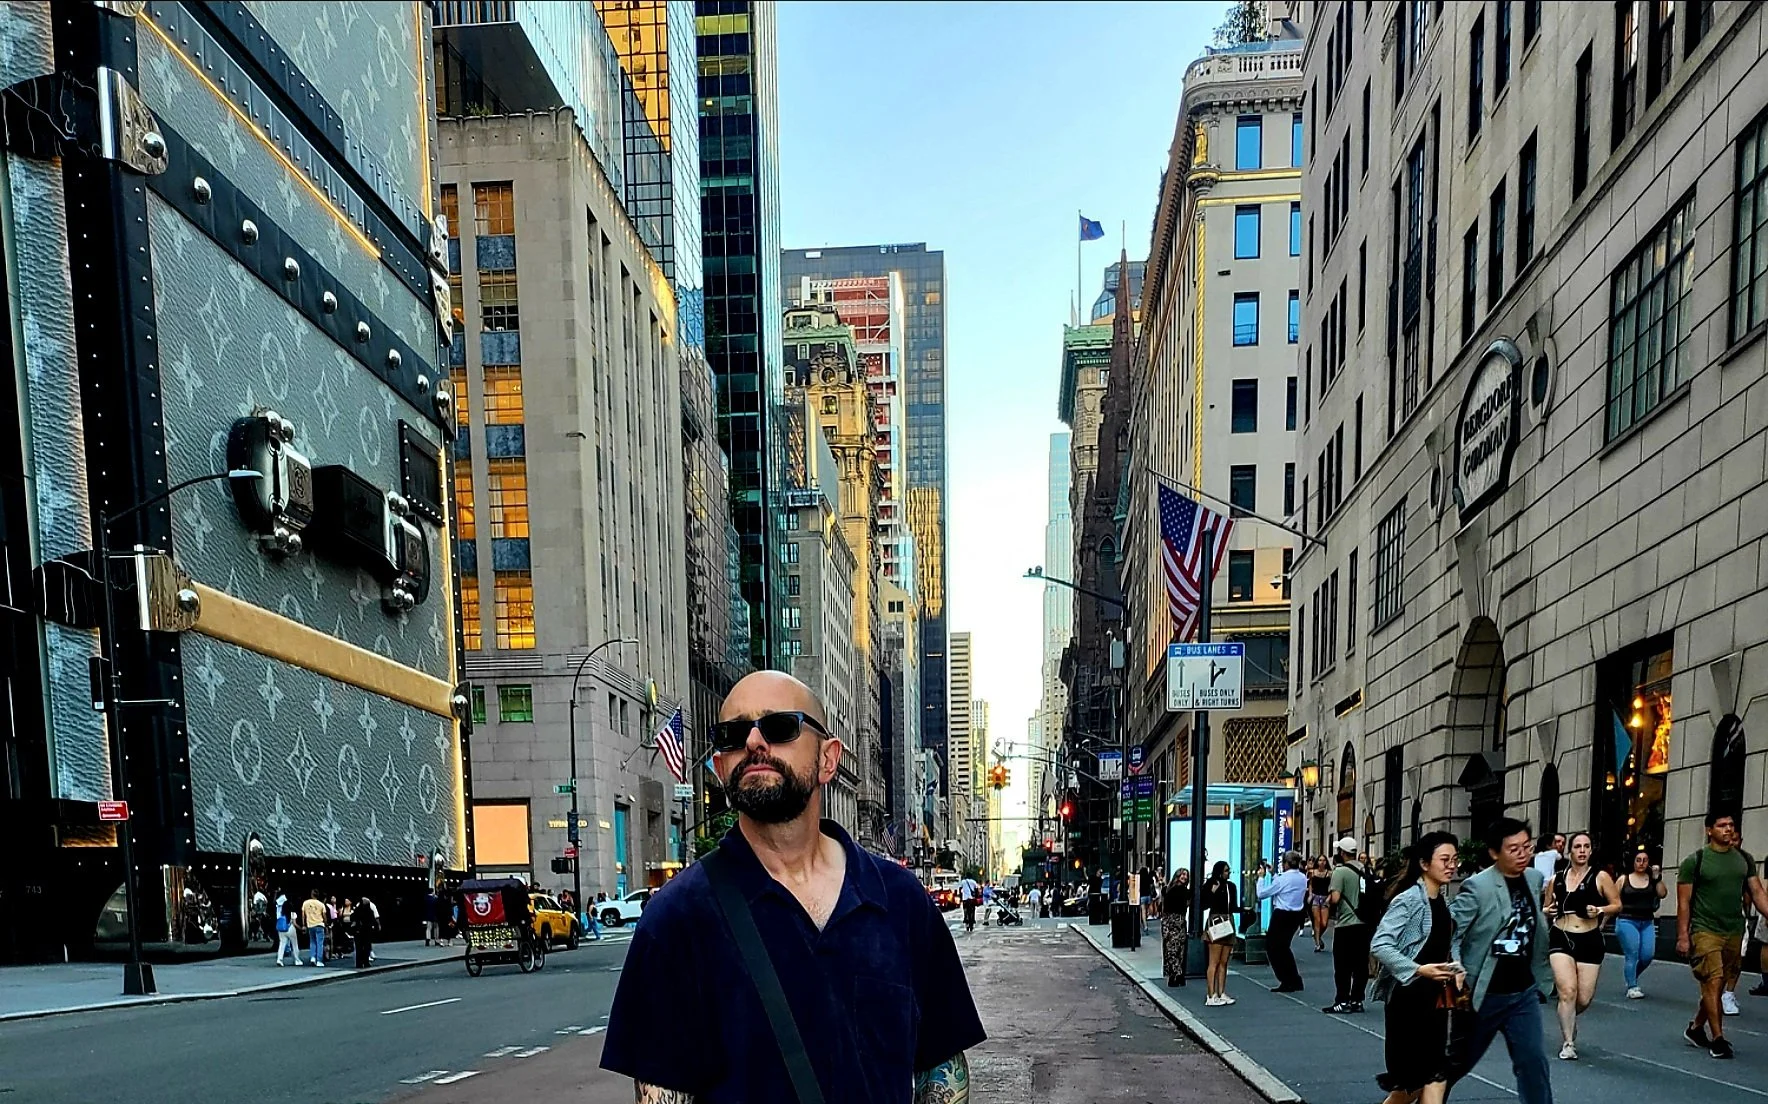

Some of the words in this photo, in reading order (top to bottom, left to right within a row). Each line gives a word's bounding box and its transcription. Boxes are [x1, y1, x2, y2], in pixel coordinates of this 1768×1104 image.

[1186, 646, 1200, 655] BUS
[1202, 645, 1226, 655] LANES
[1199, 688, 1218, 696] BUSES
[1219, 688, 1234, 696] ONLY
[1202, 698, 1219, 706] RIGHT
[1220, 698, 1239, 706] TURNS
